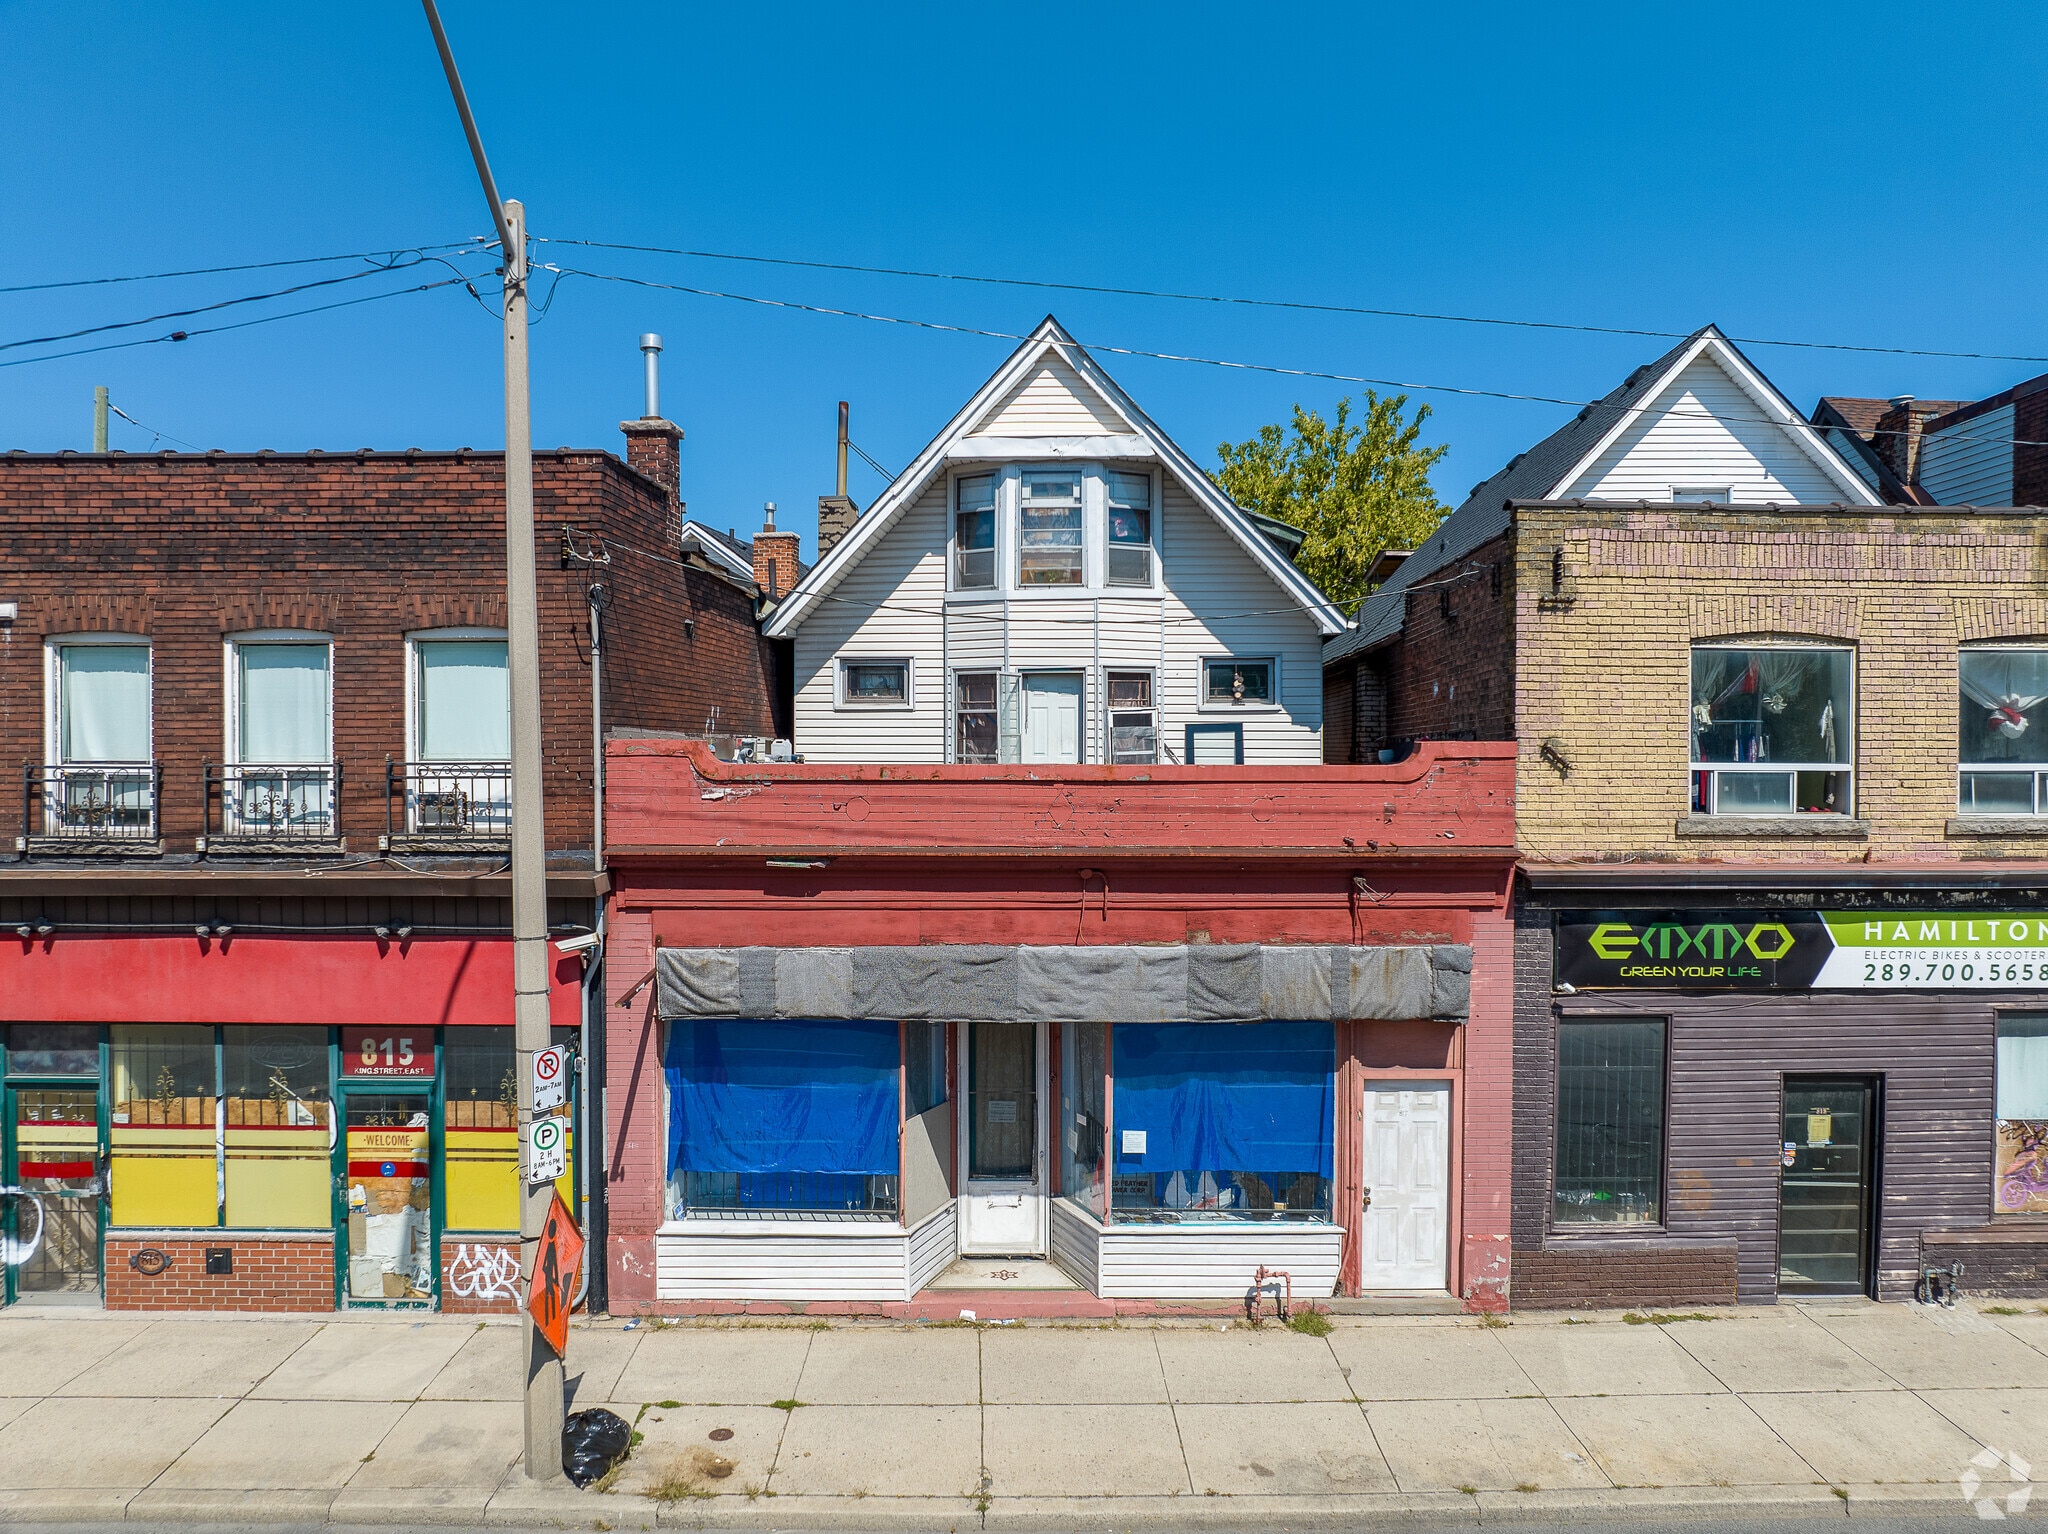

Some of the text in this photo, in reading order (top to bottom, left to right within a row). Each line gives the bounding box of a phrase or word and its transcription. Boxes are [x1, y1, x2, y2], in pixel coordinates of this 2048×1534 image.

[1864, 920, 2048, 942] HAMILTON
[1588, 922, 1796, 960] EMMO
[1864, 950, 2048, 960] ELECTRIC BIKES & SCOOTER
[1620, 966, 1762, 977] GREEN YOUR LIFE
[1863, 963, 2048, 982] 289.700.5658
[361, 1038, 415, 1066] 815
[541, 1128, 552, 1144] P
[540, 1151, 545, 1160] 2
